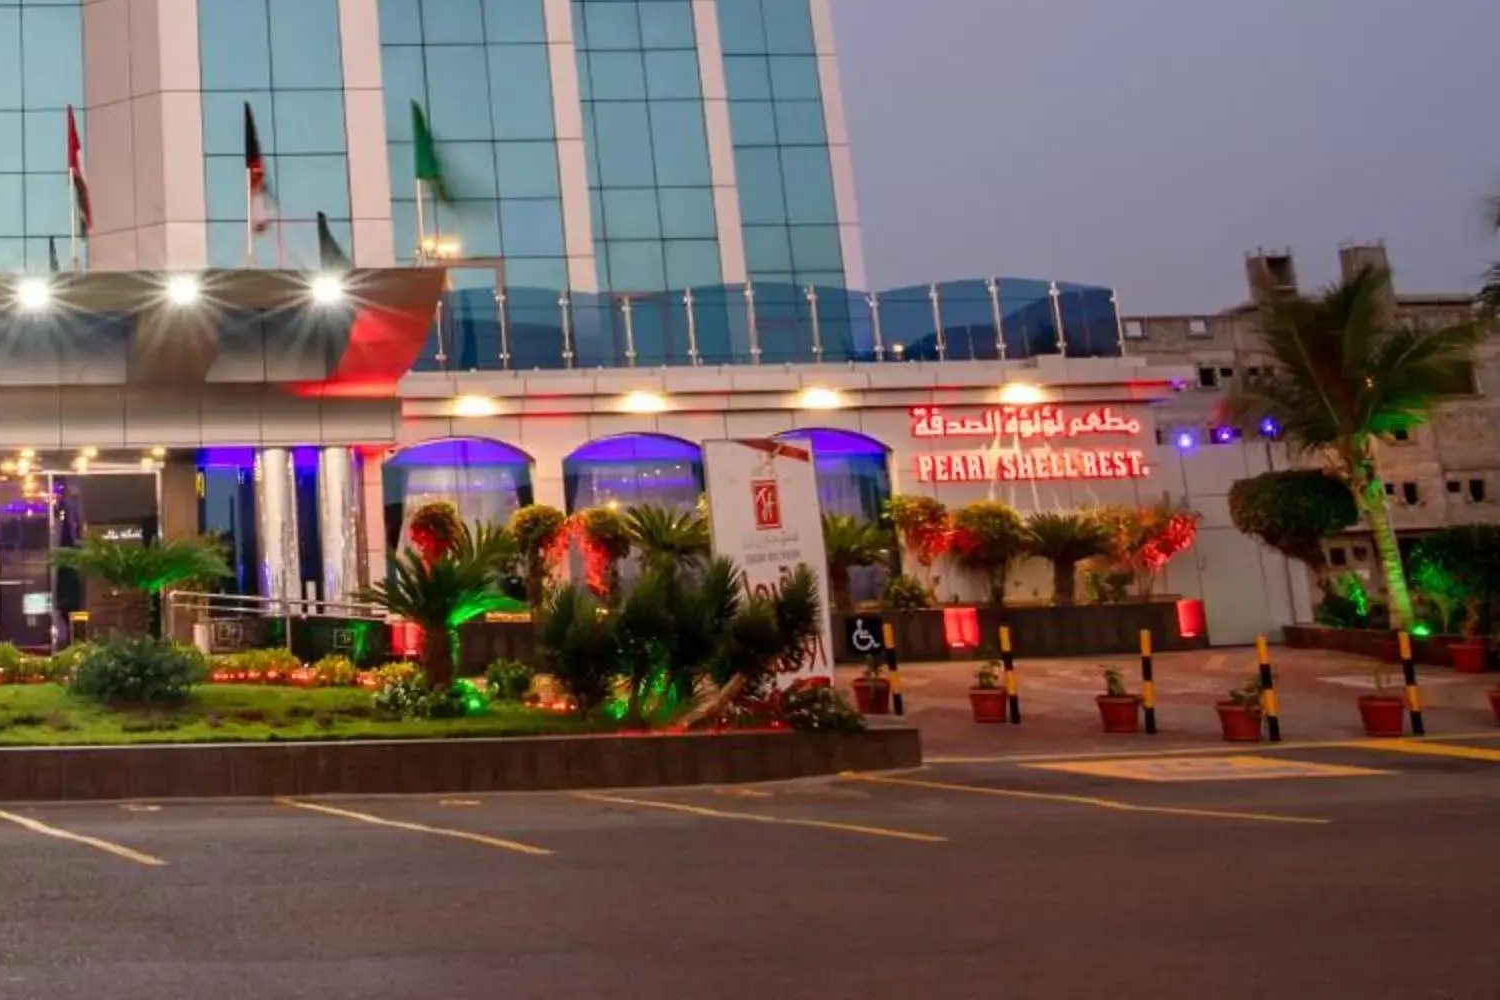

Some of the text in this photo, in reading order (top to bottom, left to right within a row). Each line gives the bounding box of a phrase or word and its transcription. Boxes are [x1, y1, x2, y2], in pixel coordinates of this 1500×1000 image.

[912, 406, 1001, 436] الصدفة
[1067, 407, 1141, 437] مطعم
[919, 450, 1150, 481] PEARL SHELL REST.
